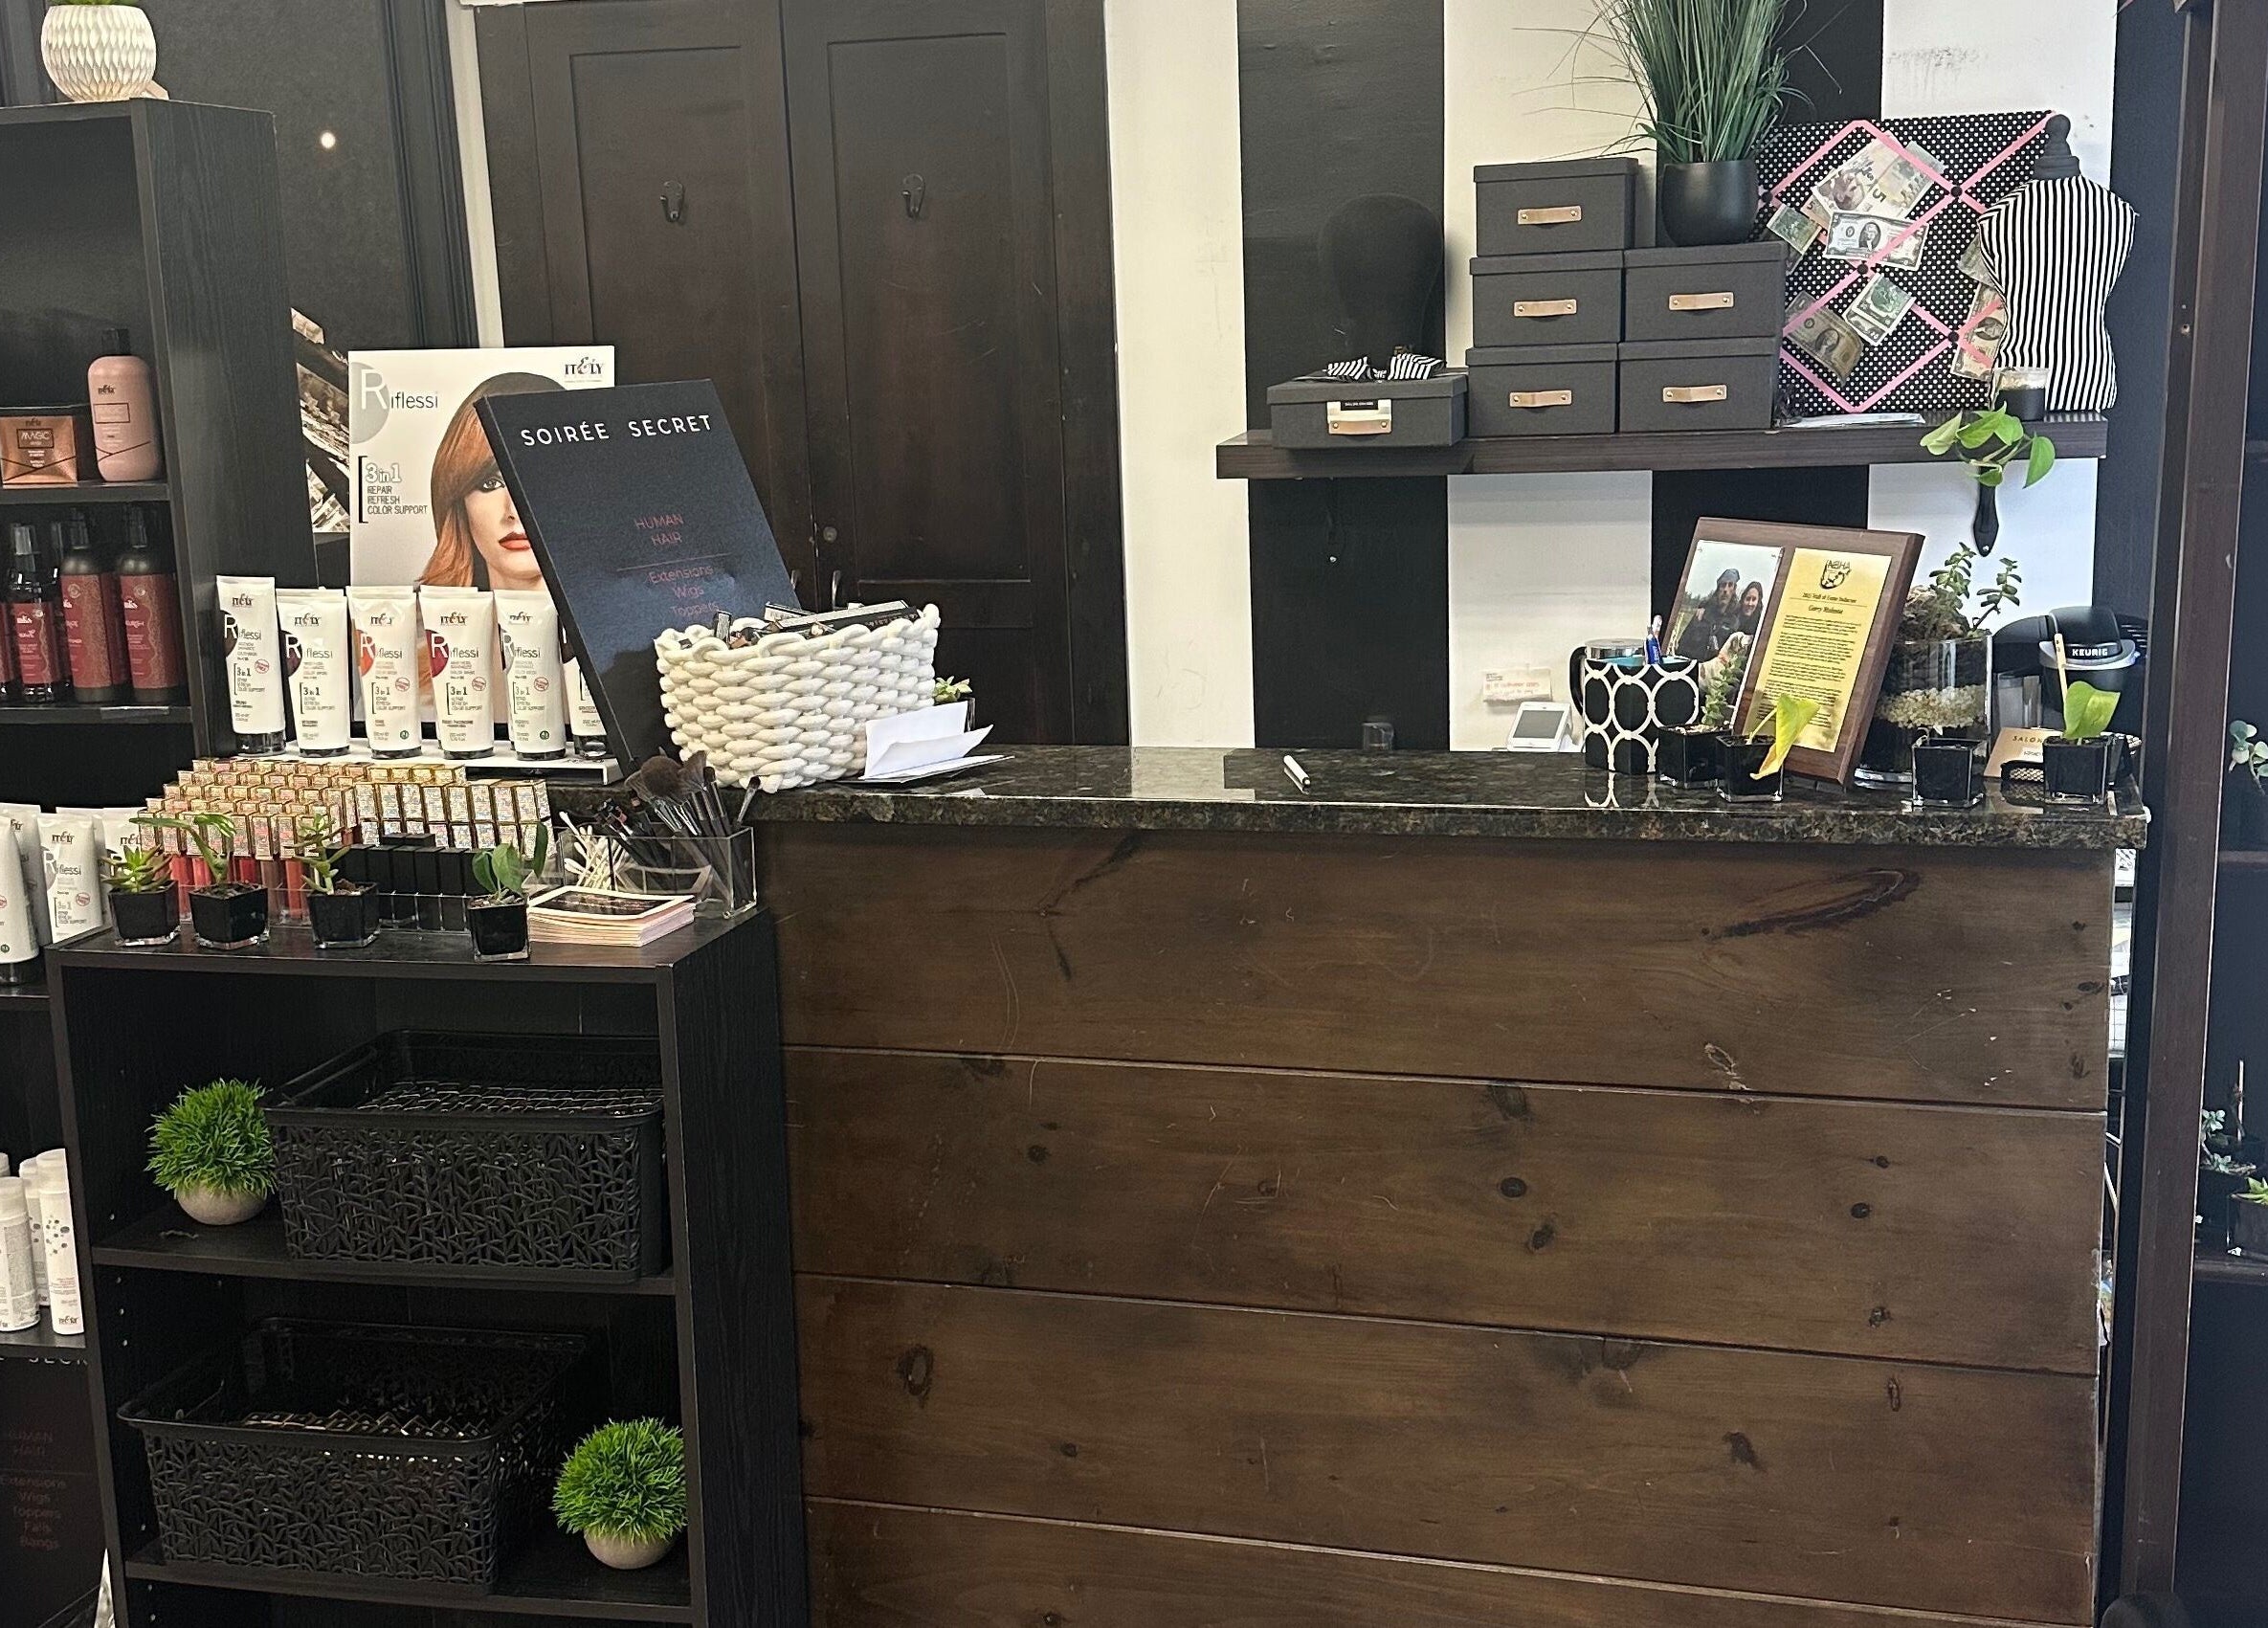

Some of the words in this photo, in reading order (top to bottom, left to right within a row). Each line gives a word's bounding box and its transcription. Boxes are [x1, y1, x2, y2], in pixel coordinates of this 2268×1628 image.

[1873, 189, 1887, 203] 5
[361, 369, 438, 410] Riflessi
[521, 421, 610, 447] SOIRÉE
[628, 413, 712, 438] SECRET
[367, 485, 392, 494] REPAIR
[367, 496, 400, 504] REFRESH
[367, 505, 392, 514] COLOR
[394, 505, 428, 514] SUPPORT
[634, 513, 684, 529] HUMAN
[651, 531, 682, 546] HAIR
[649, 566, 714, 584] Extensions
[672, 585, 704, 599] Wigs
[2072, 648, 2108, 657] KEURIG
